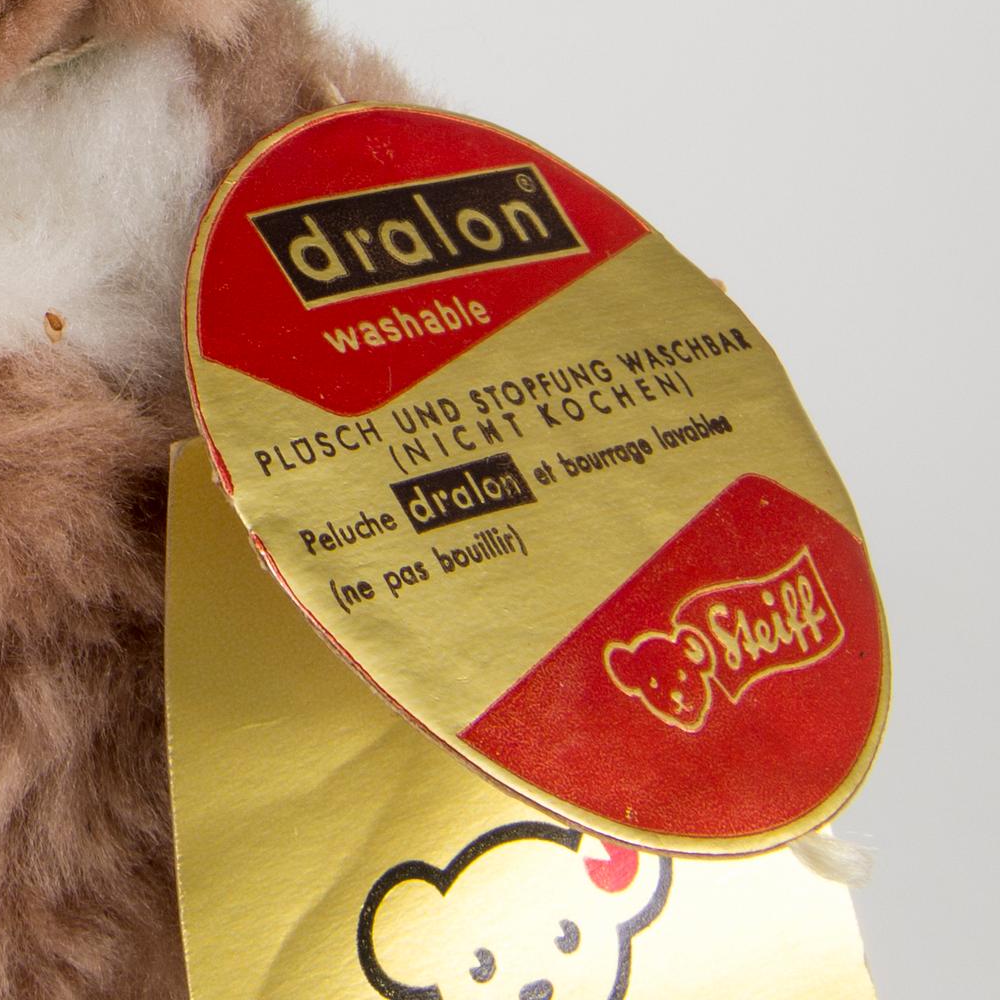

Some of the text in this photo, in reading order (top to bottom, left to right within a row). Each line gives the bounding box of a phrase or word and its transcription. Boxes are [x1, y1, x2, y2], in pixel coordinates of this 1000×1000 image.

[323, 296, 491, 353] washable
[392, 398, 461, 434] UND
[469, 360, 612, 414] STOPFUNG
[616, 328, 752, 374] WASCHBAR
[536, 370, 694, 428] KOCHEN)
[299, 413, 733, 556] Peluche dralon et bourrage lavables
[329, 523, 528, 614] (ne pas bouillir)
[707, 574, 826, 670] Steiff
